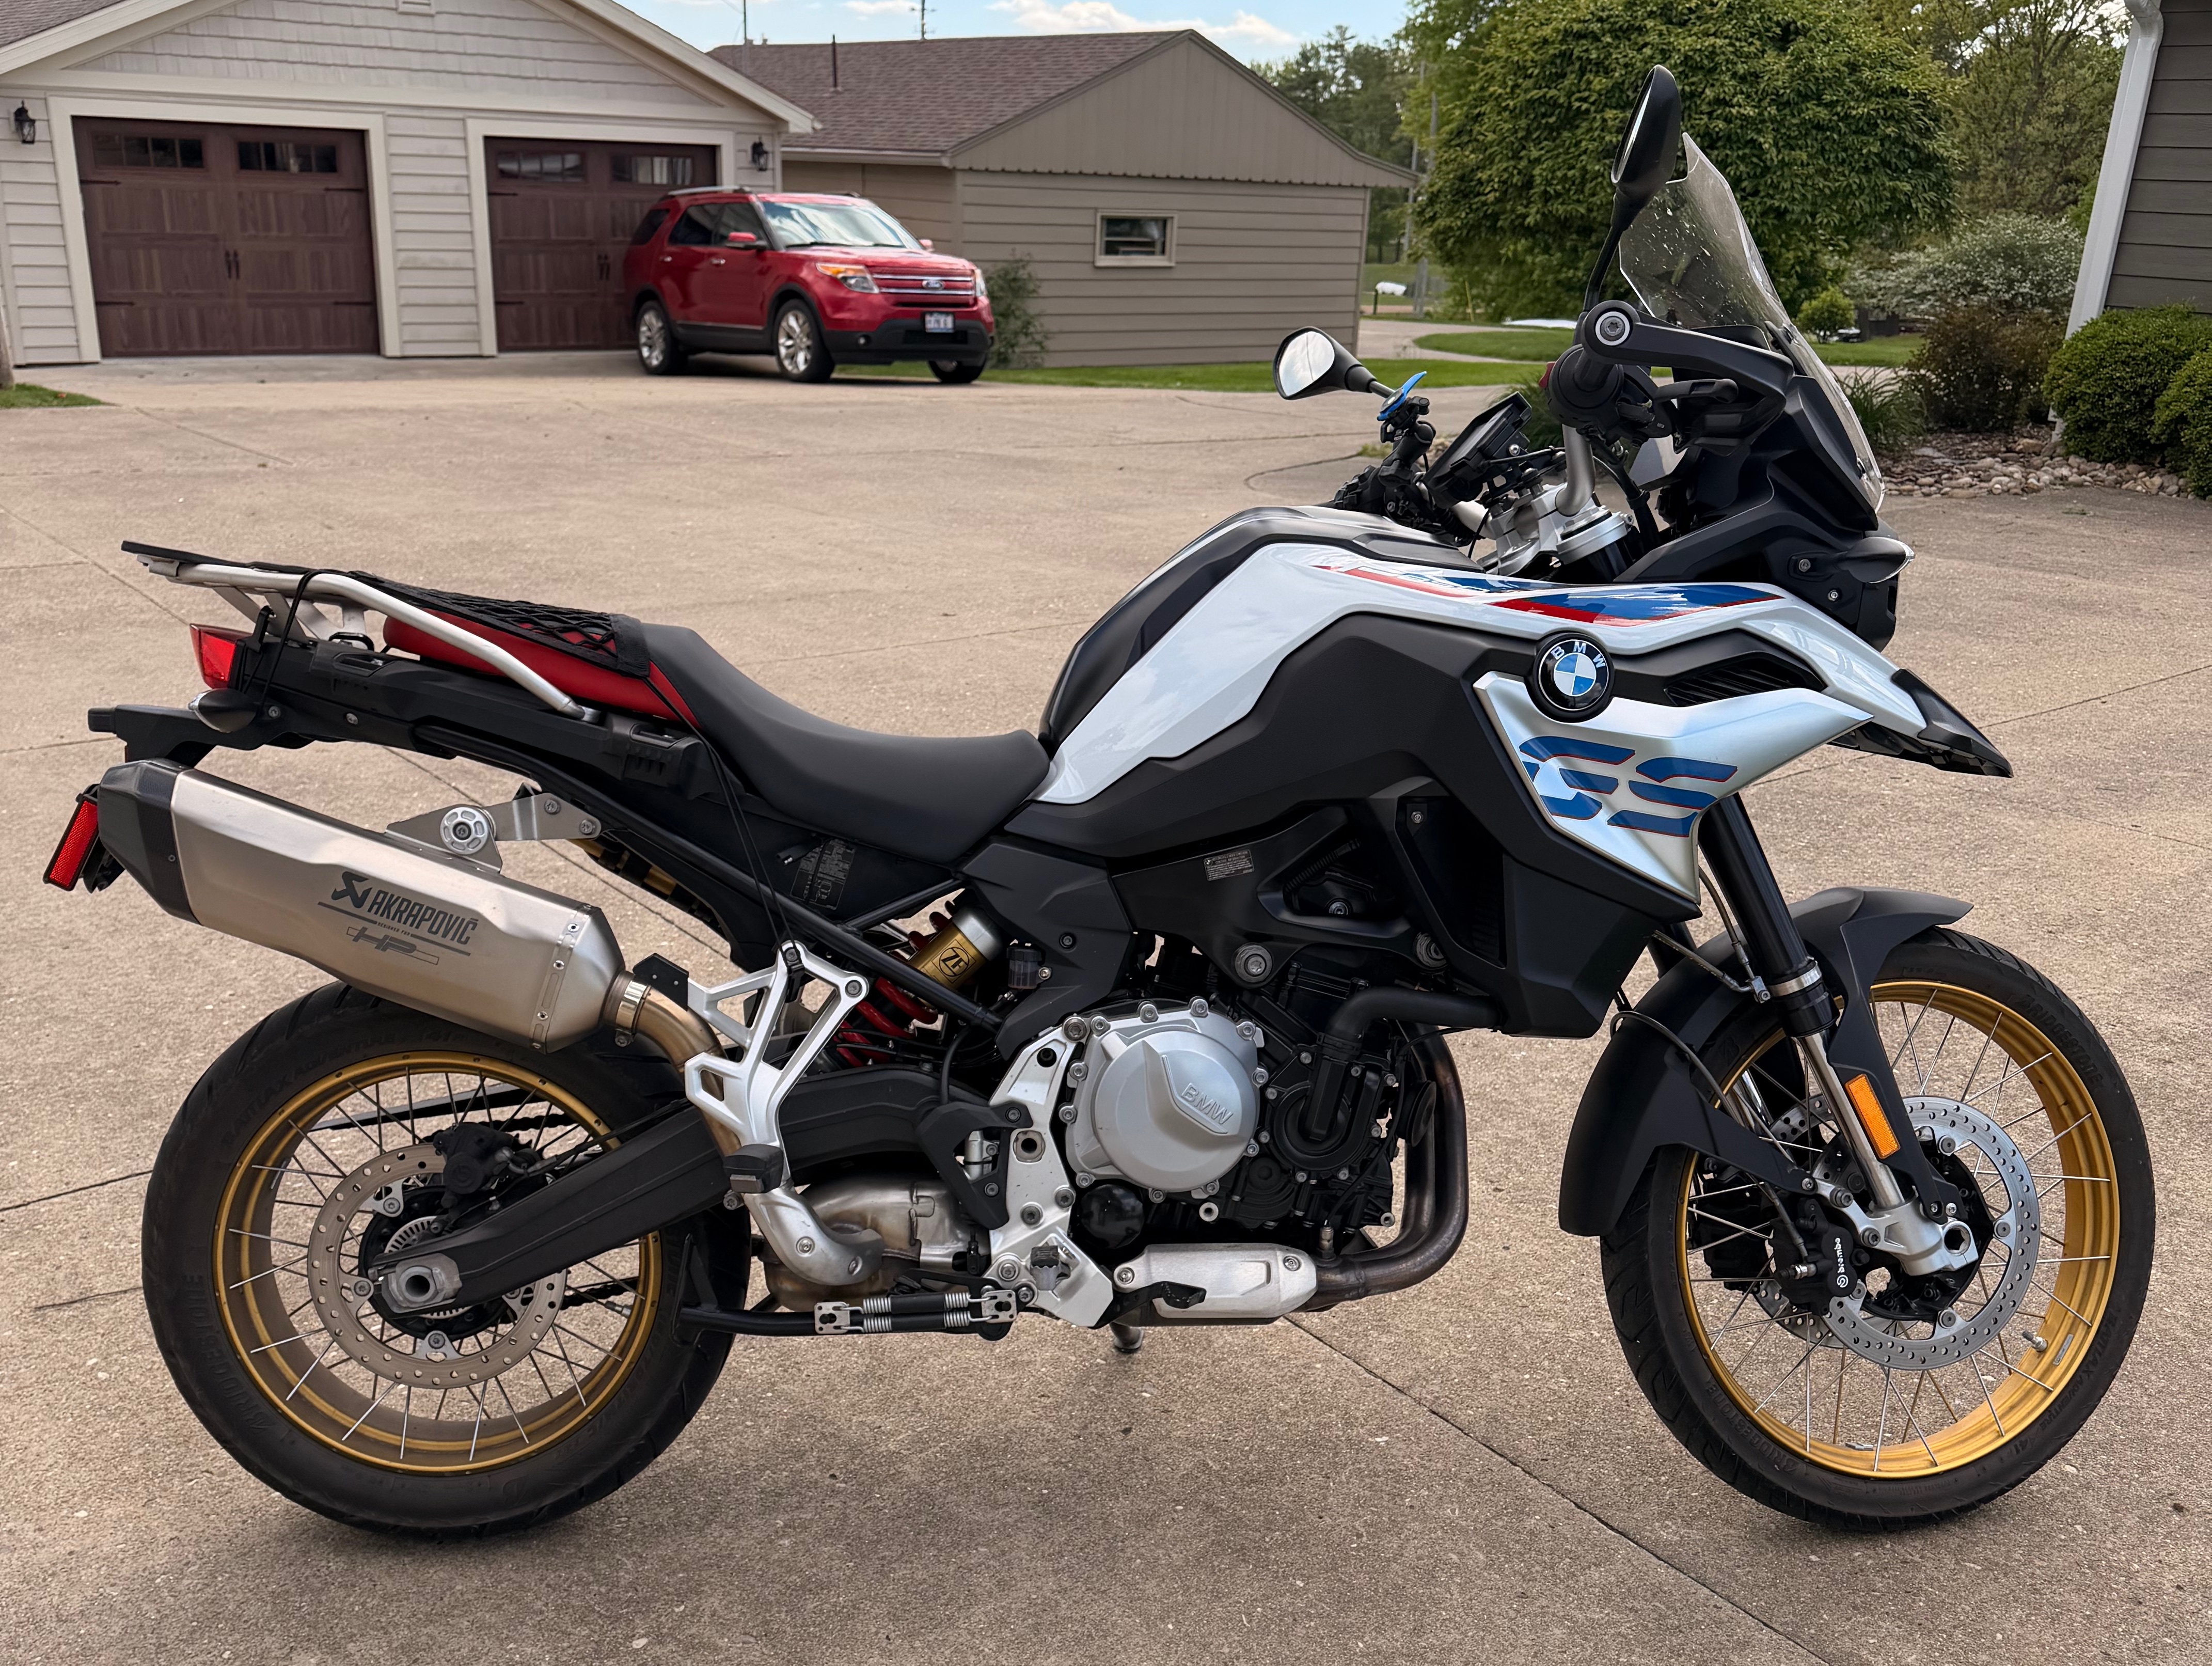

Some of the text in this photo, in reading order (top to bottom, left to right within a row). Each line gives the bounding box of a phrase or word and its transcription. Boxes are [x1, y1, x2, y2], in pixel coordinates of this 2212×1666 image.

[1551, 641, 1606, 668] BMW
[1519, 735, 1738, 838] GS
[352, 926, 417, 952] HP
[941, 948, 968, 976] ZF
[2015, 994, 2103, 1087] BRIDGESTONE
[1181, 1082, 1234, 1125] BMW
[1834, 1237, 1845, 1274] brembo
[1706, 1384, 1797, 1473] BRIDGESTONE
